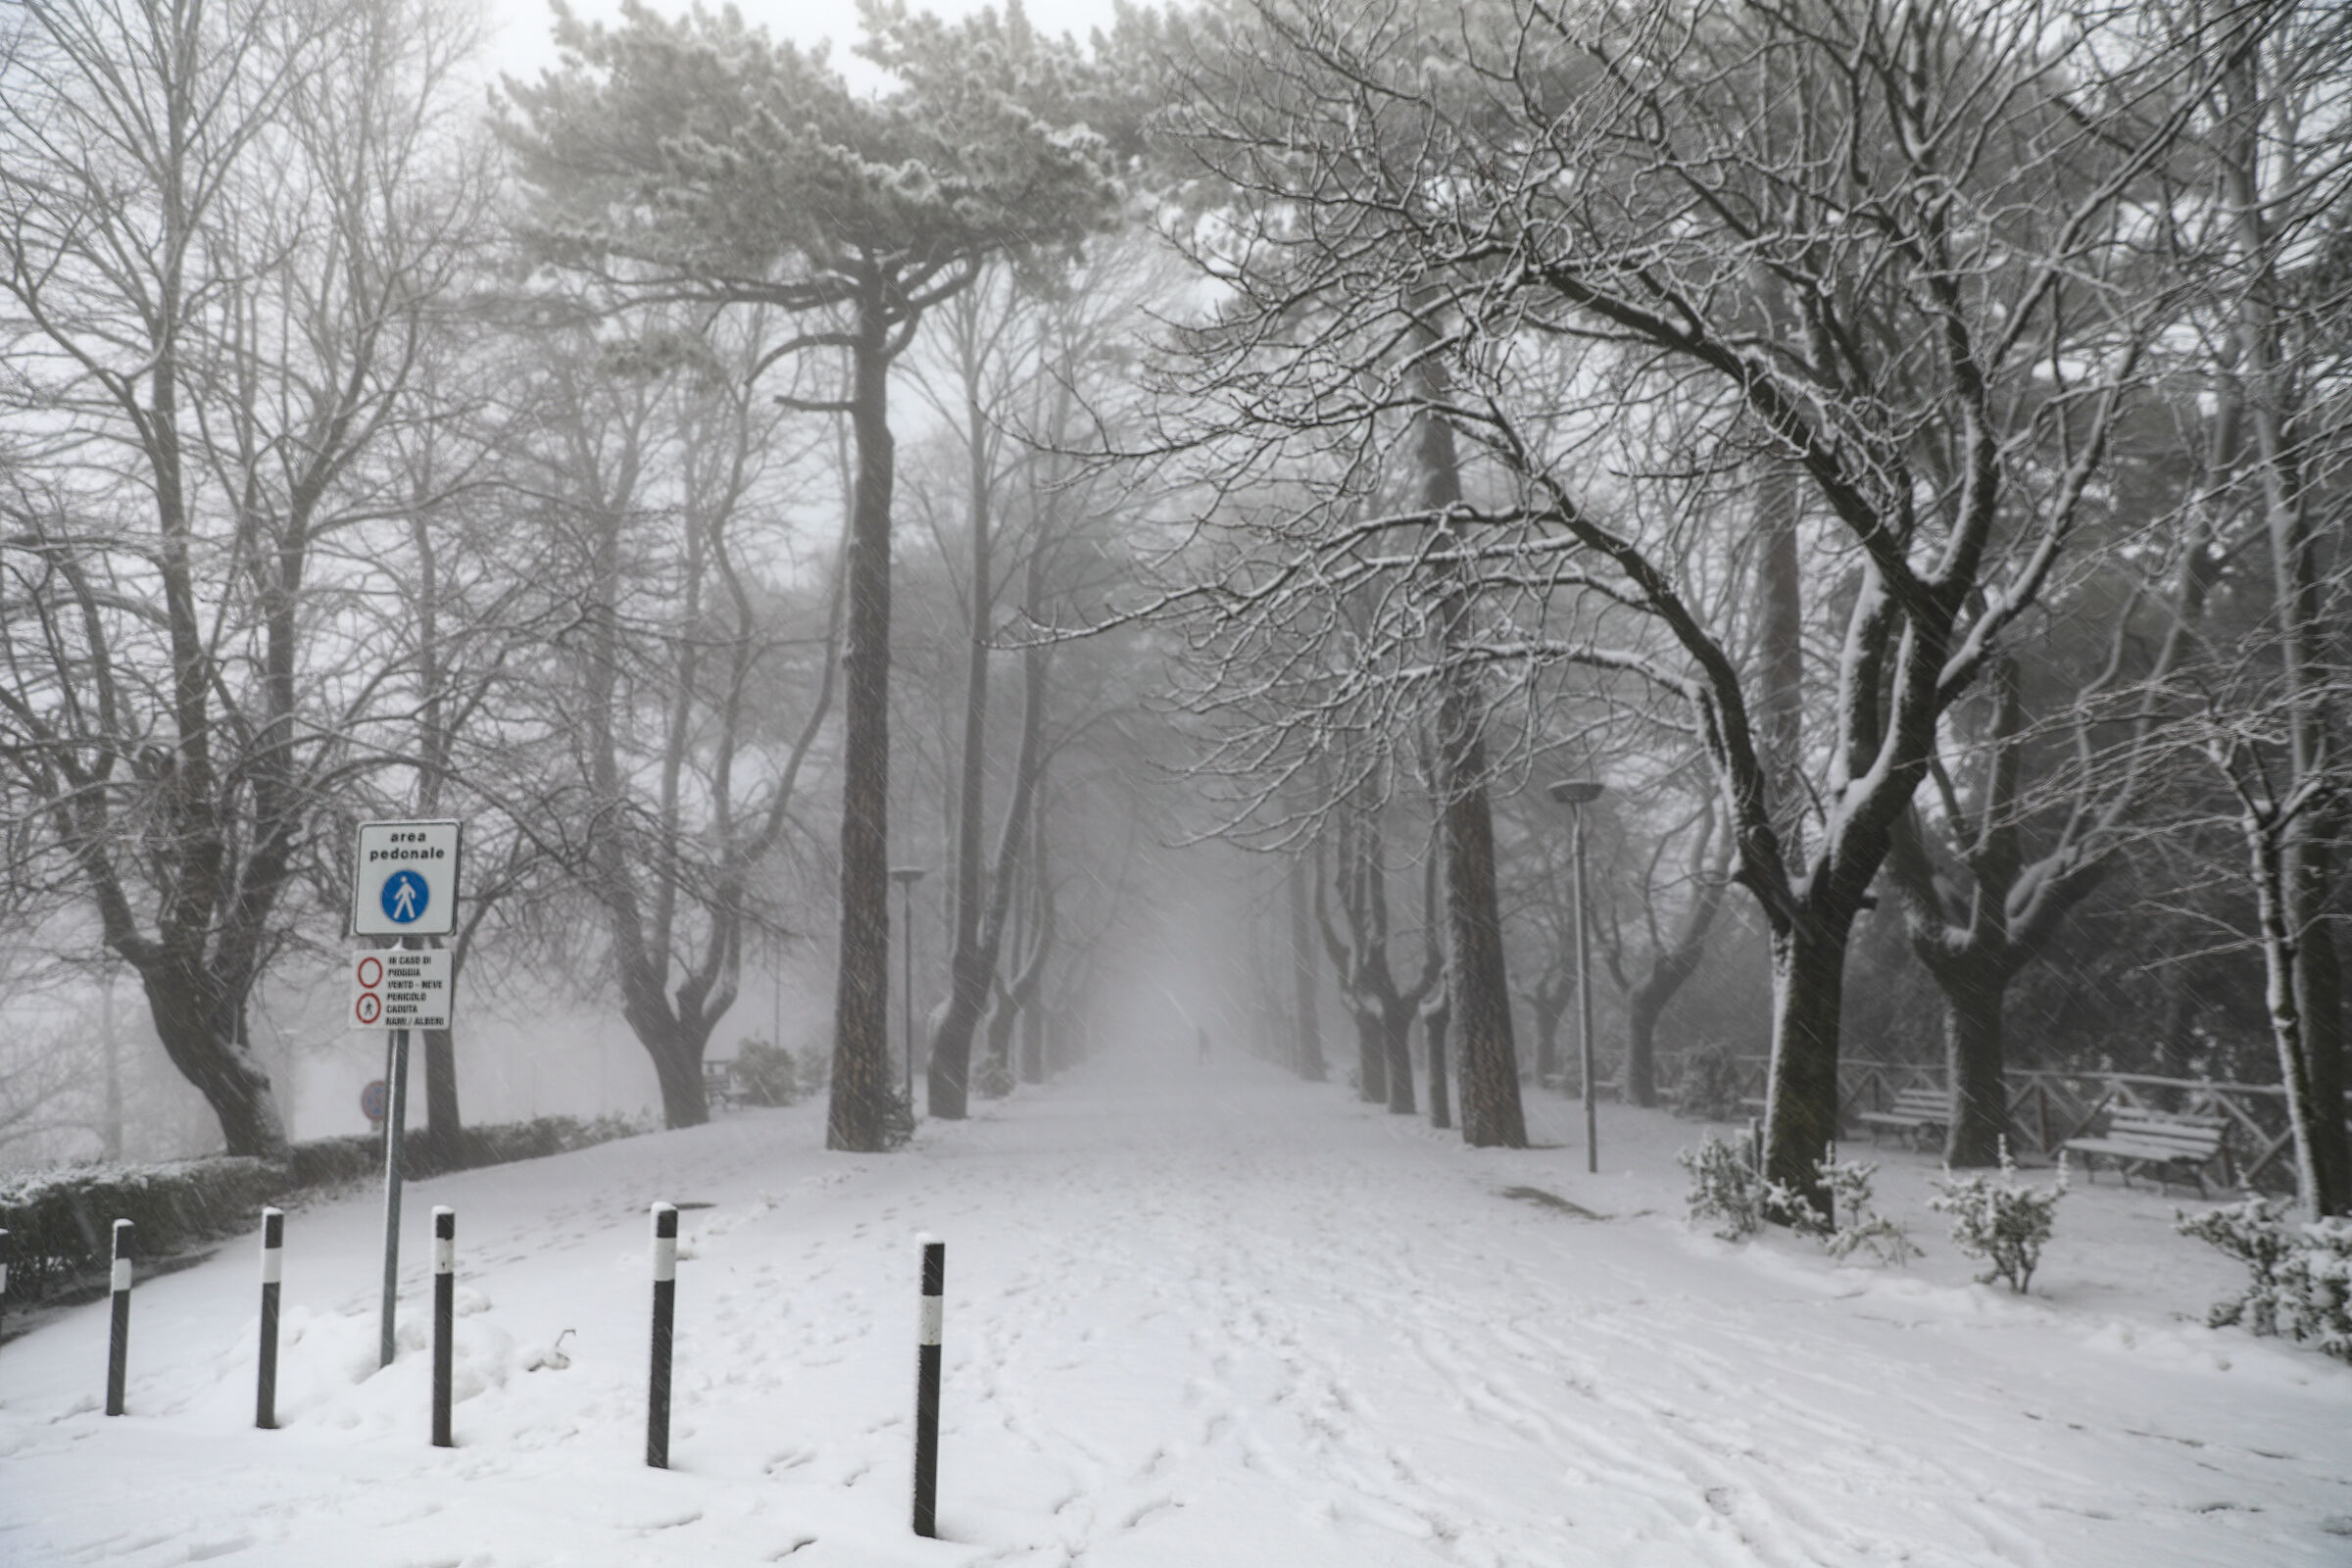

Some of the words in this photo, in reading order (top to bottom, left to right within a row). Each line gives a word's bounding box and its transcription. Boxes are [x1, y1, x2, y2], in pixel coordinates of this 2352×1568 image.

[390, 832, 426, 843] area
[369, 847, 445, 862] pedonale
[387, 968, 421, 977] PIOGGIA
[387, 980, 414, 989] VENTO
[420, 980, 443, 989] NEVE
[386, 993, 427, 1002] PERICOLO
[386, 1004, 418, 1013] CADUTA
